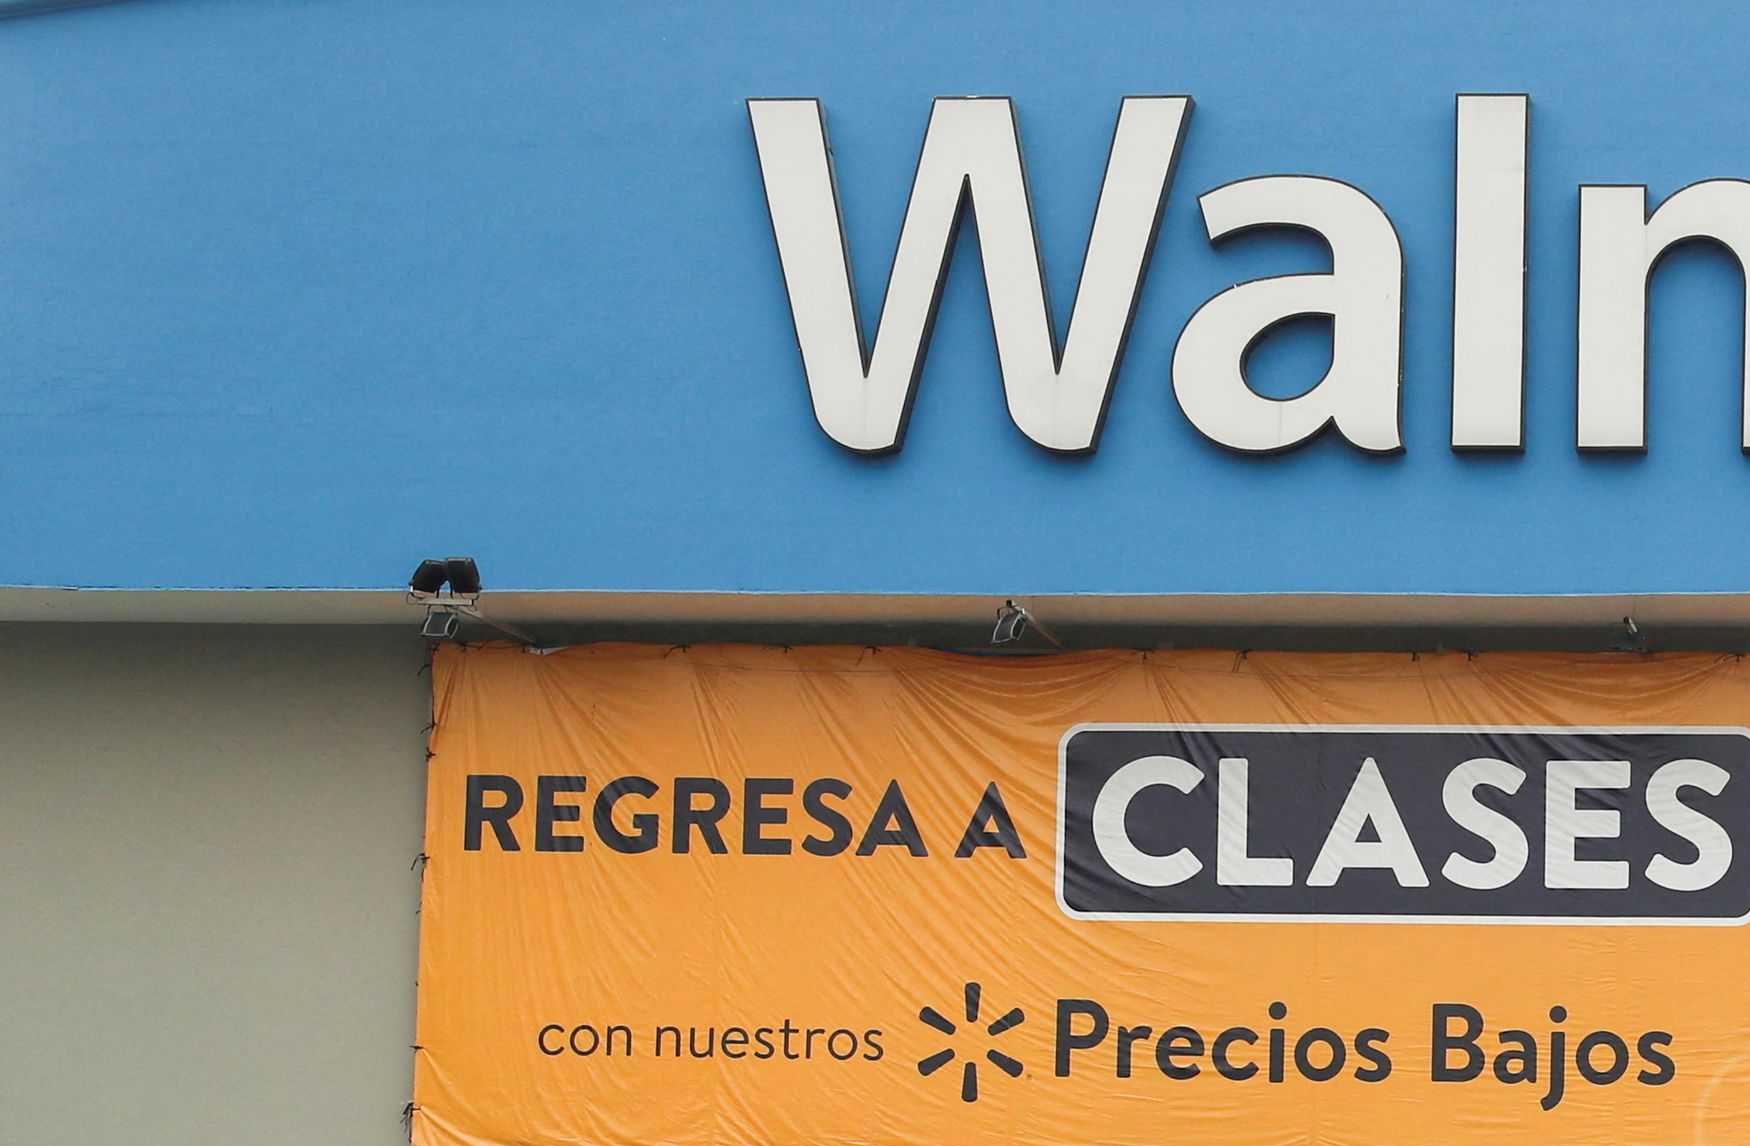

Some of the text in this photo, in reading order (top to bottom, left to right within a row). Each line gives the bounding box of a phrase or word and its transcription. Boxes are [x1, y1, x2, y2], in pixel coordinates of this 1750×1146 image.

[463, 774, 1027, 859] REGRESA A
[1092, 754, 1734, 891] CLASES
[537, 998, 1677, 1112] con nuestros Precios Bajos
